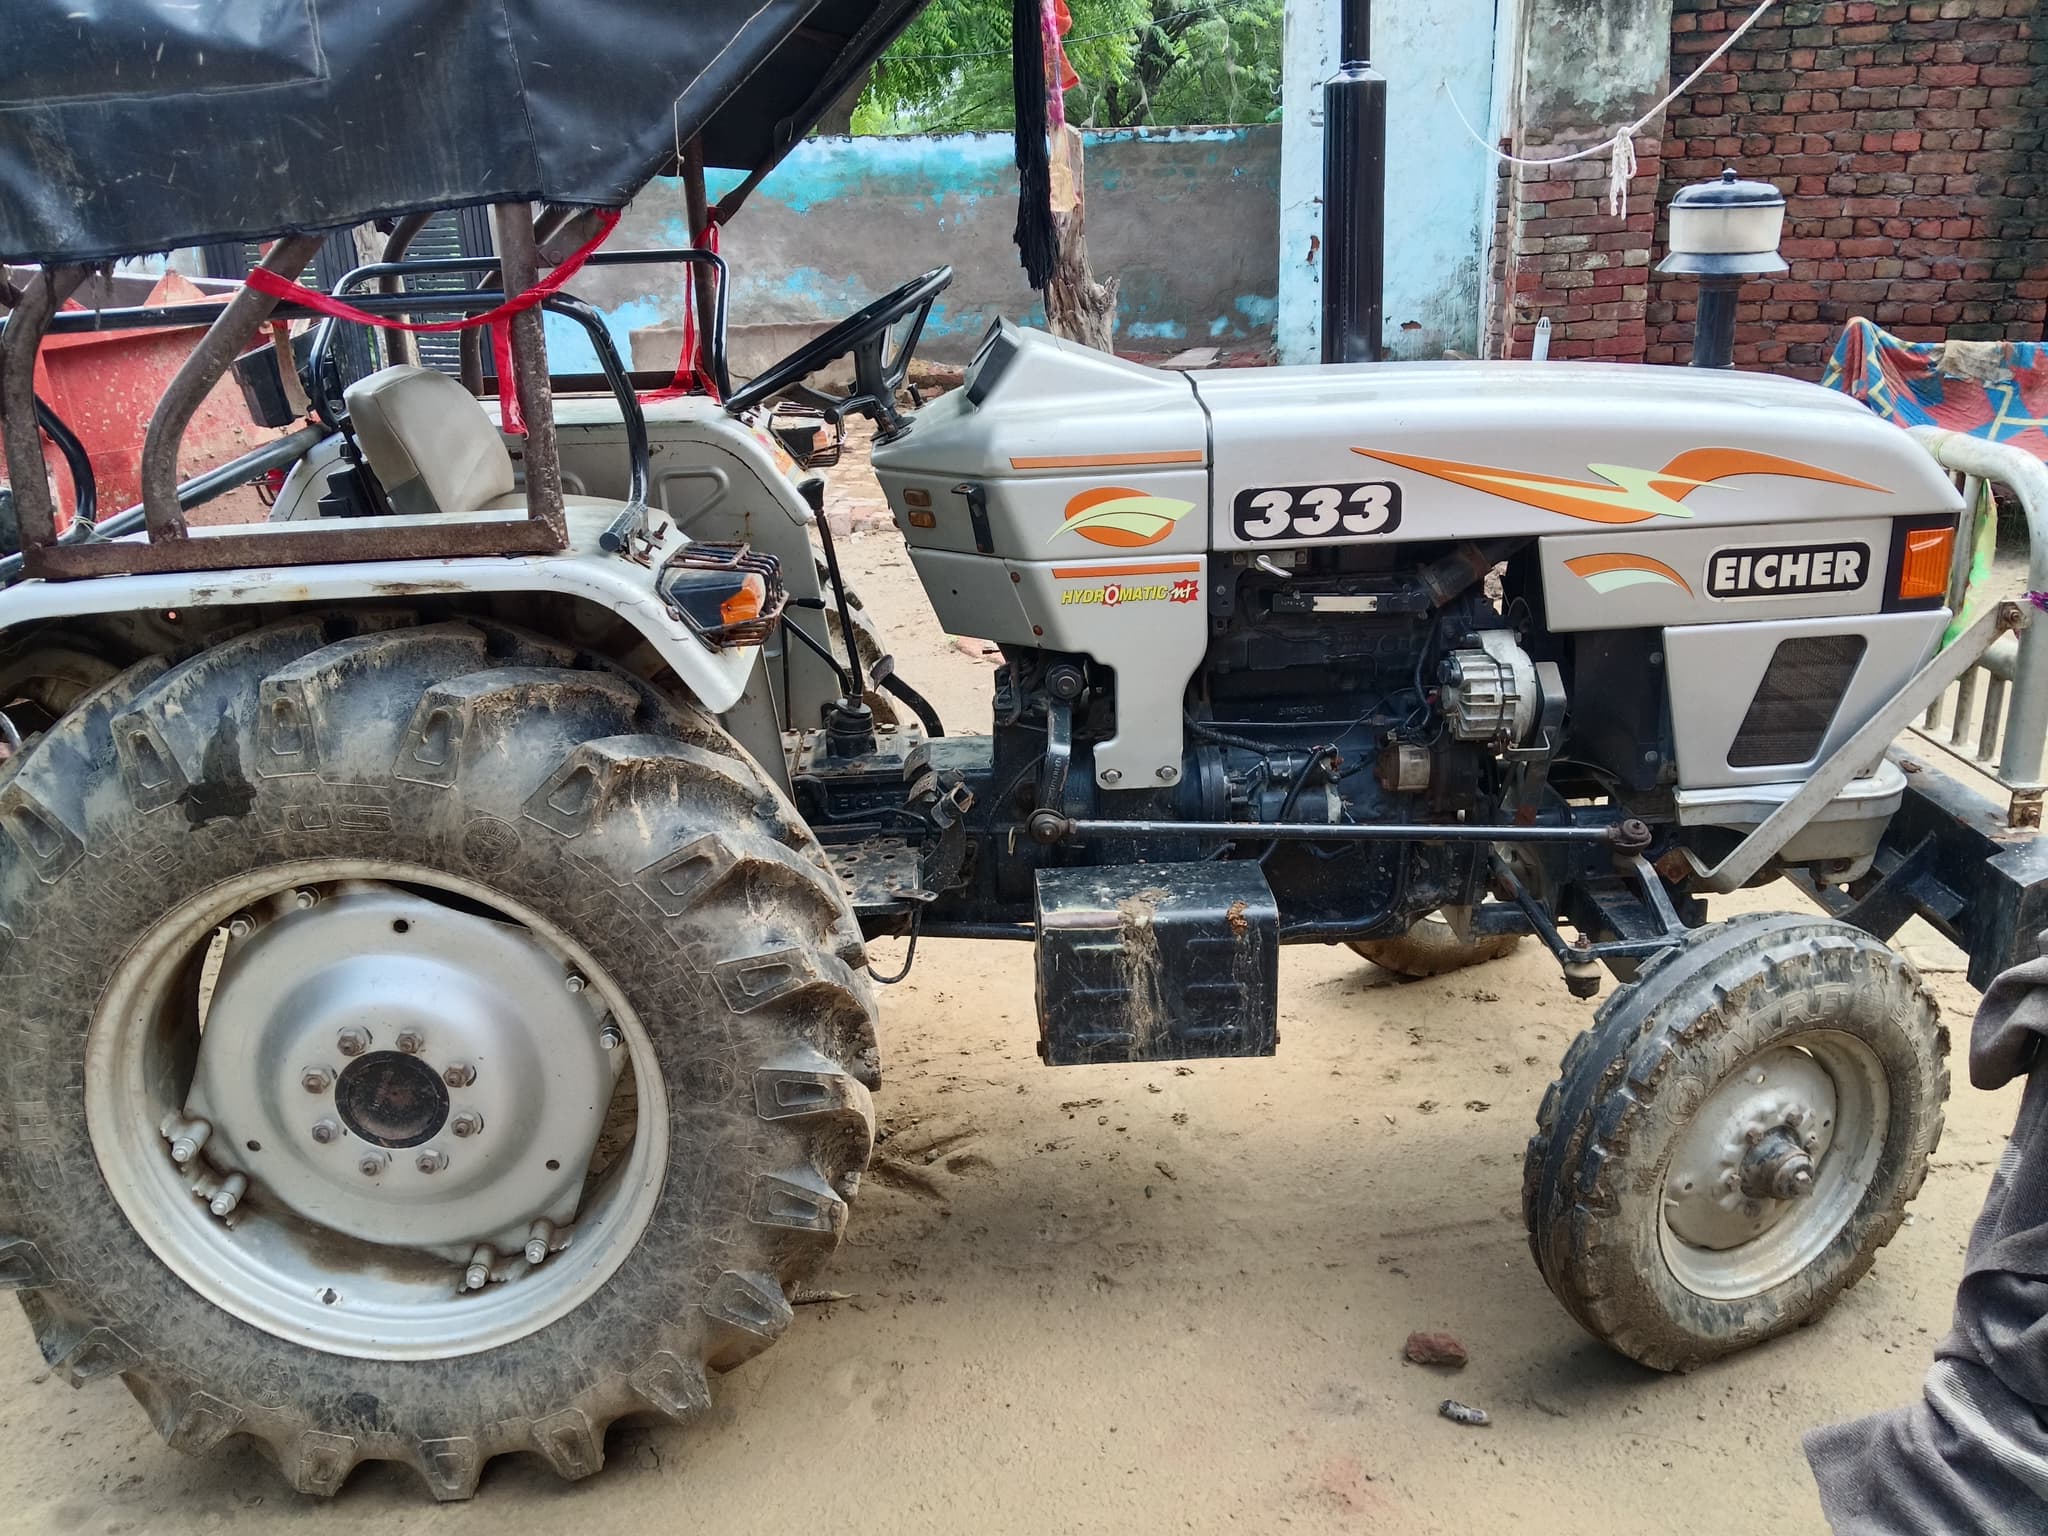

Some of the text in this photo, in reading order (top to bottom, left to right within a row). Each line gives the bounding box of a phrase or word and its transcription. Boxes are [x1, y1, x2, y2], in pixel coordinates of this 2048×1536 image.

[1244, 484, 1392, 538] 333
[1714, 550, 1861, 591] EICHER
[1061, 584, 1169, 605] HYDROMATIC
